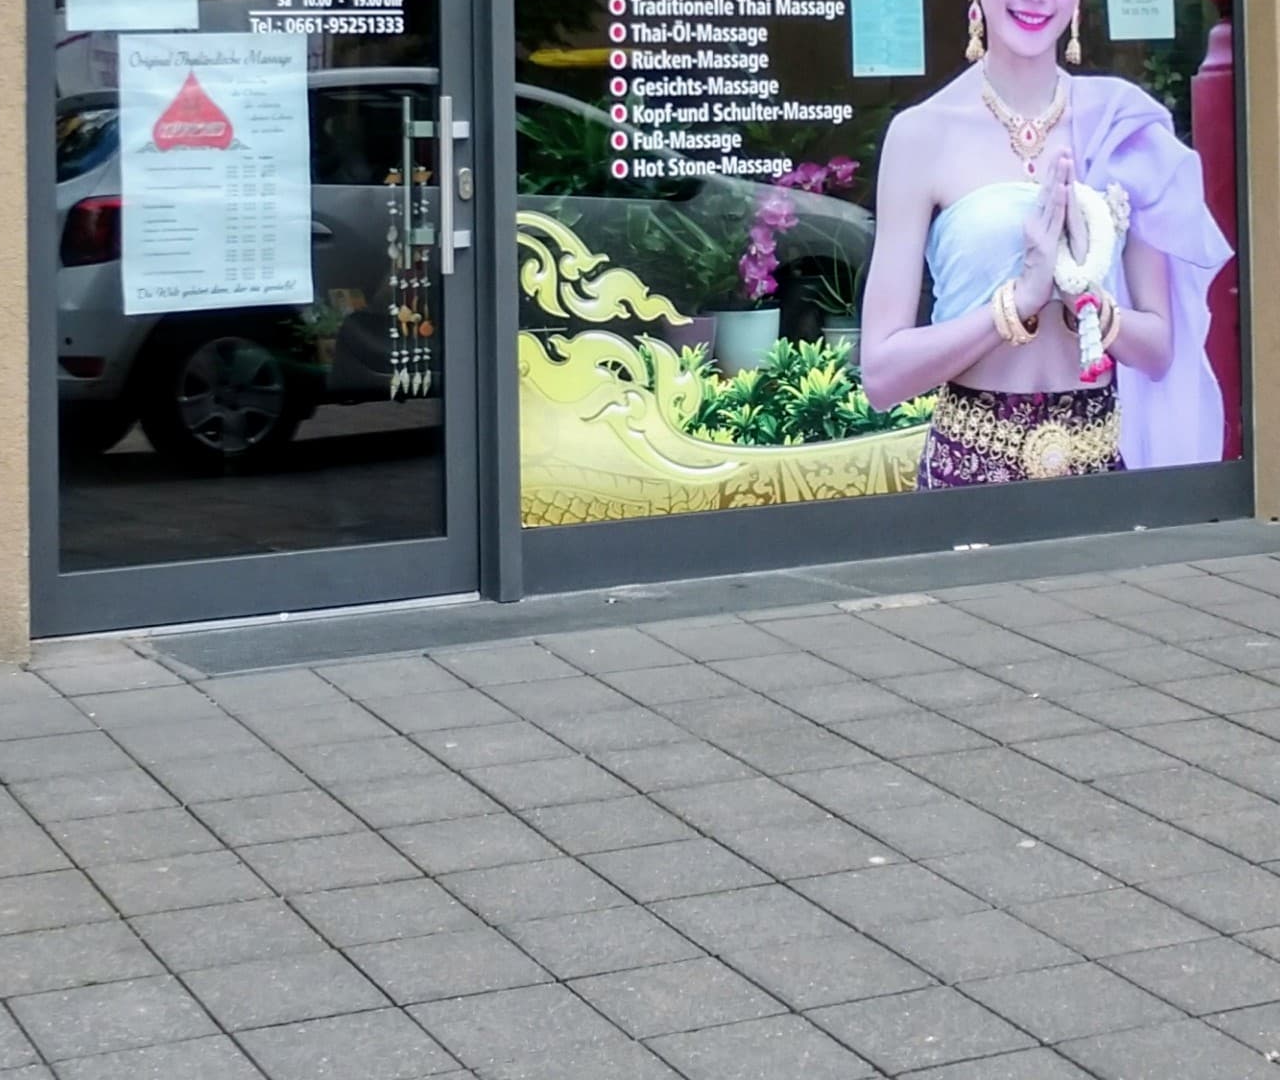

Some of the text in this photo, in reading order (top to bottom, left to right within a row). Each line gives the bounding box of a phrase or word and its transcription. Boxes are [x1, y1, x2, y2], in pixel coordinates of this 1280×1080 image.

[250, 17, 404, 33] Tel.: 0661-95251333
[630, 21, 768, 46] Thai-Öl-Massage
[631, 50, 769, 73] Rücken-Massage
[632, 76, 779, 99] Gesichts-Massage
[632, 101, 853, 128] Kopf-und Schulter-Massage
[633, 131, 742, 152] Fuß-Massage
[633, 155, 792, 178] Hot Stone-Massage
